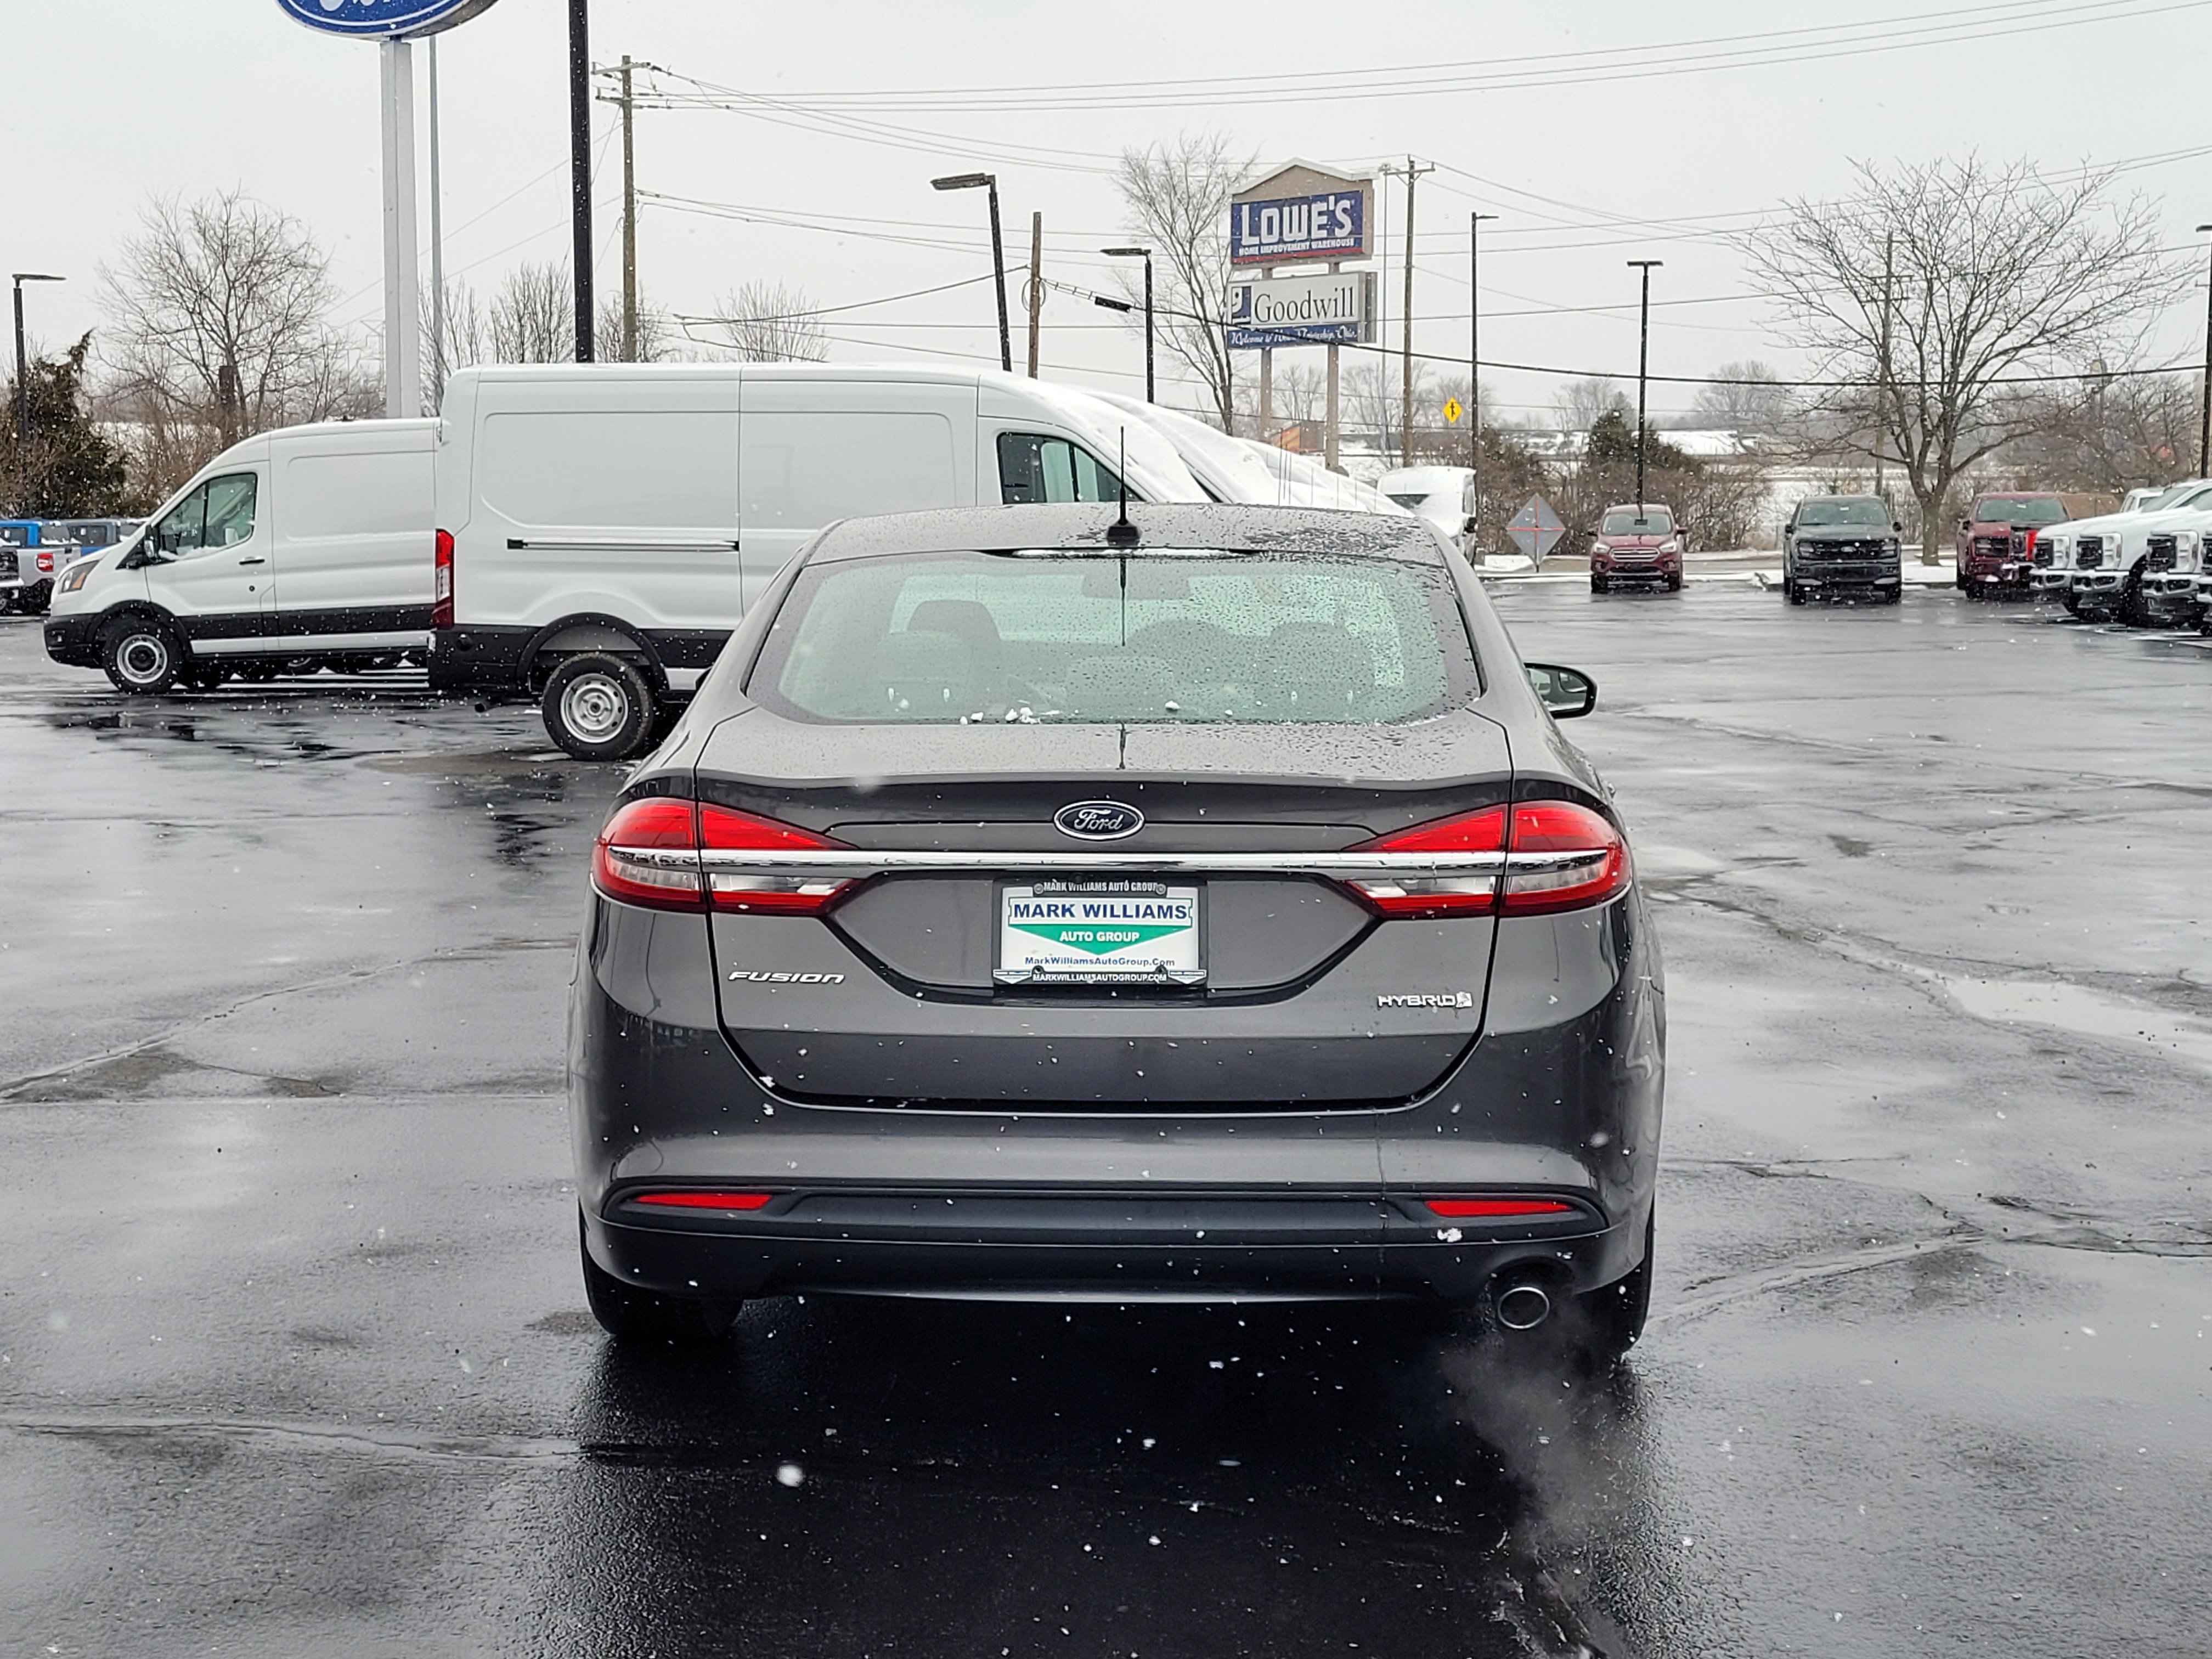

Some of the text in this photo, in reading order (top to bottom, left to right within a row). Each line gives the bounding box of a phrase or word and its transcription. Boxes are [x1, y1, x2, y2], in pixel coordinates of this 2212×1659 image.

[1242, 195, 1352, 246] LOWE'S
[1239, 238, 1355, 256] HOME IMPROVEMENT WAREHOUSE
[1255, 286, 1355, 323] Goodwill
[1074, 808, 1124, 830] Ford
[1043, 882, 1067, 891] MARK
[1068, 882, 1107, 891] WILLIAMS
[1108, 882, 1129, 891] AUTO
[1014, 904, 1188, 919] MARK WILLIAMS
[1059, 931, 1140, 943] AUTO GROUP
[1024, 957, 1175, 967] MarkWilliamsAutoGroup.Com
[728, 971, 845, 984] FUSION
[1032, 973, 1167, 983] MARKWILLIAMSAUTOGROUP.COM
[1377, 995, 1456, 1007] HYBRID
